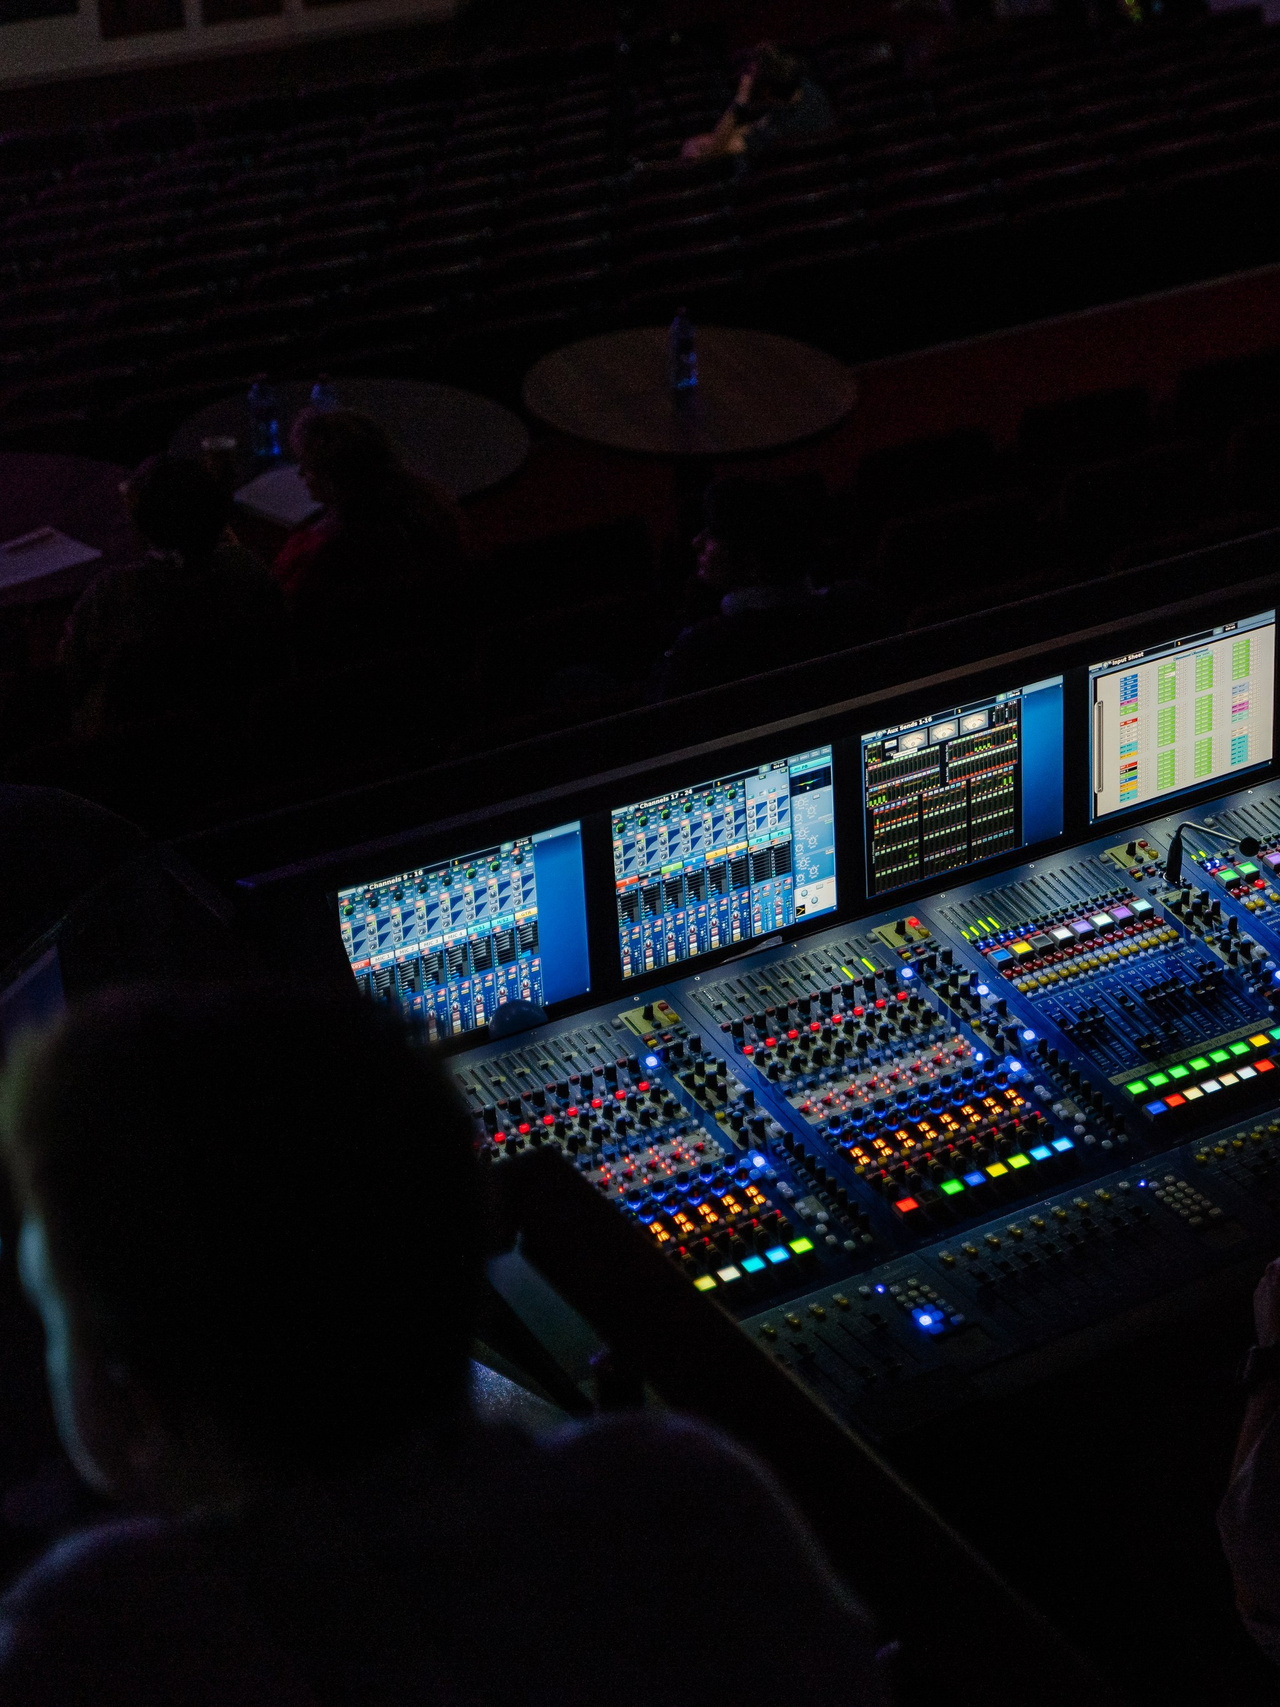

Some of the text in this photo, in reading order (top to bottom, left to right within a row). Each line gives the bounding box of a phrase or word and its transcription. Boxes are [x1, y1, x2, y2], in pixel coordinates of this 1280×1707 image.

[1112, 652, 1144, 666] Input Sheet
[887, 727, 898, 735] Aux
[899, 721, 918, 732] Sends
[639, 796, 670, 809] Channels
[670, 792, 679, 800] 17
[684, 788, 693, 796] 24
[369, 876, 402, 890] Channels
[414, 869, 423, 877] 16
[851, 1089, 1018, 1158] 15 15 15 15 15 15 15 15
[648, 1185, 759, 1234] 15 15 15 15 15
